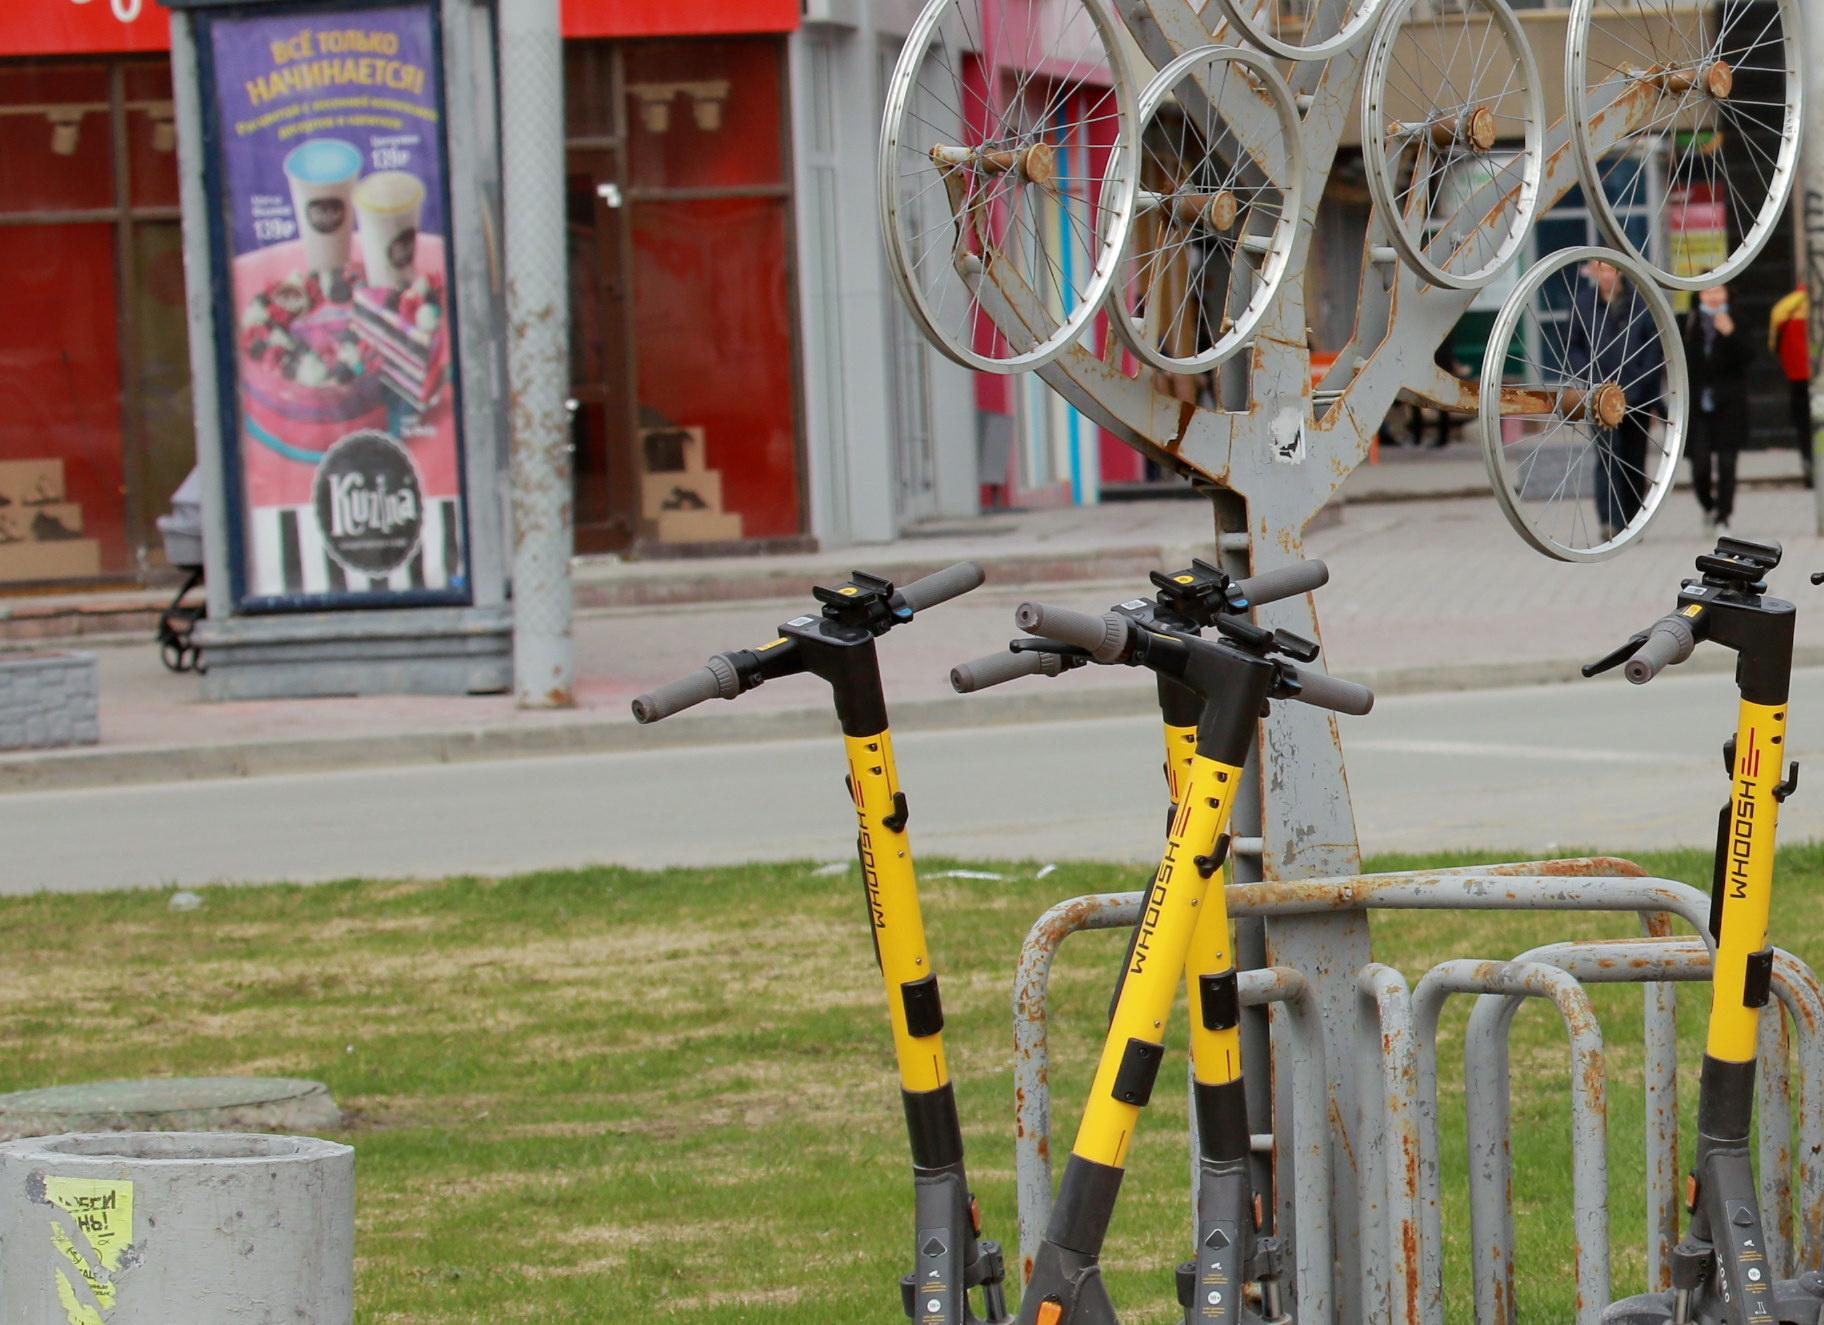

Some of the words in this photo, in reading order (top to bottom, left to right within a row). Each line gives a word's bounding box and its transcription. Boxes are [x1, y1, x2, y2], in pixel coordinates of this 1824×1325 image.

[270, 28, 315, 65] ВСЁ
[318, 29, 400, 56] ТОЛЬКО
[246, 57, 425, 106] НАЧИНАЕТСЯ!
[328, 472, 417, 537] Kuzina
[1730, 779, 1756, 899] WHOOSH
[1130, 840, 1180, 975] WHOOSH
